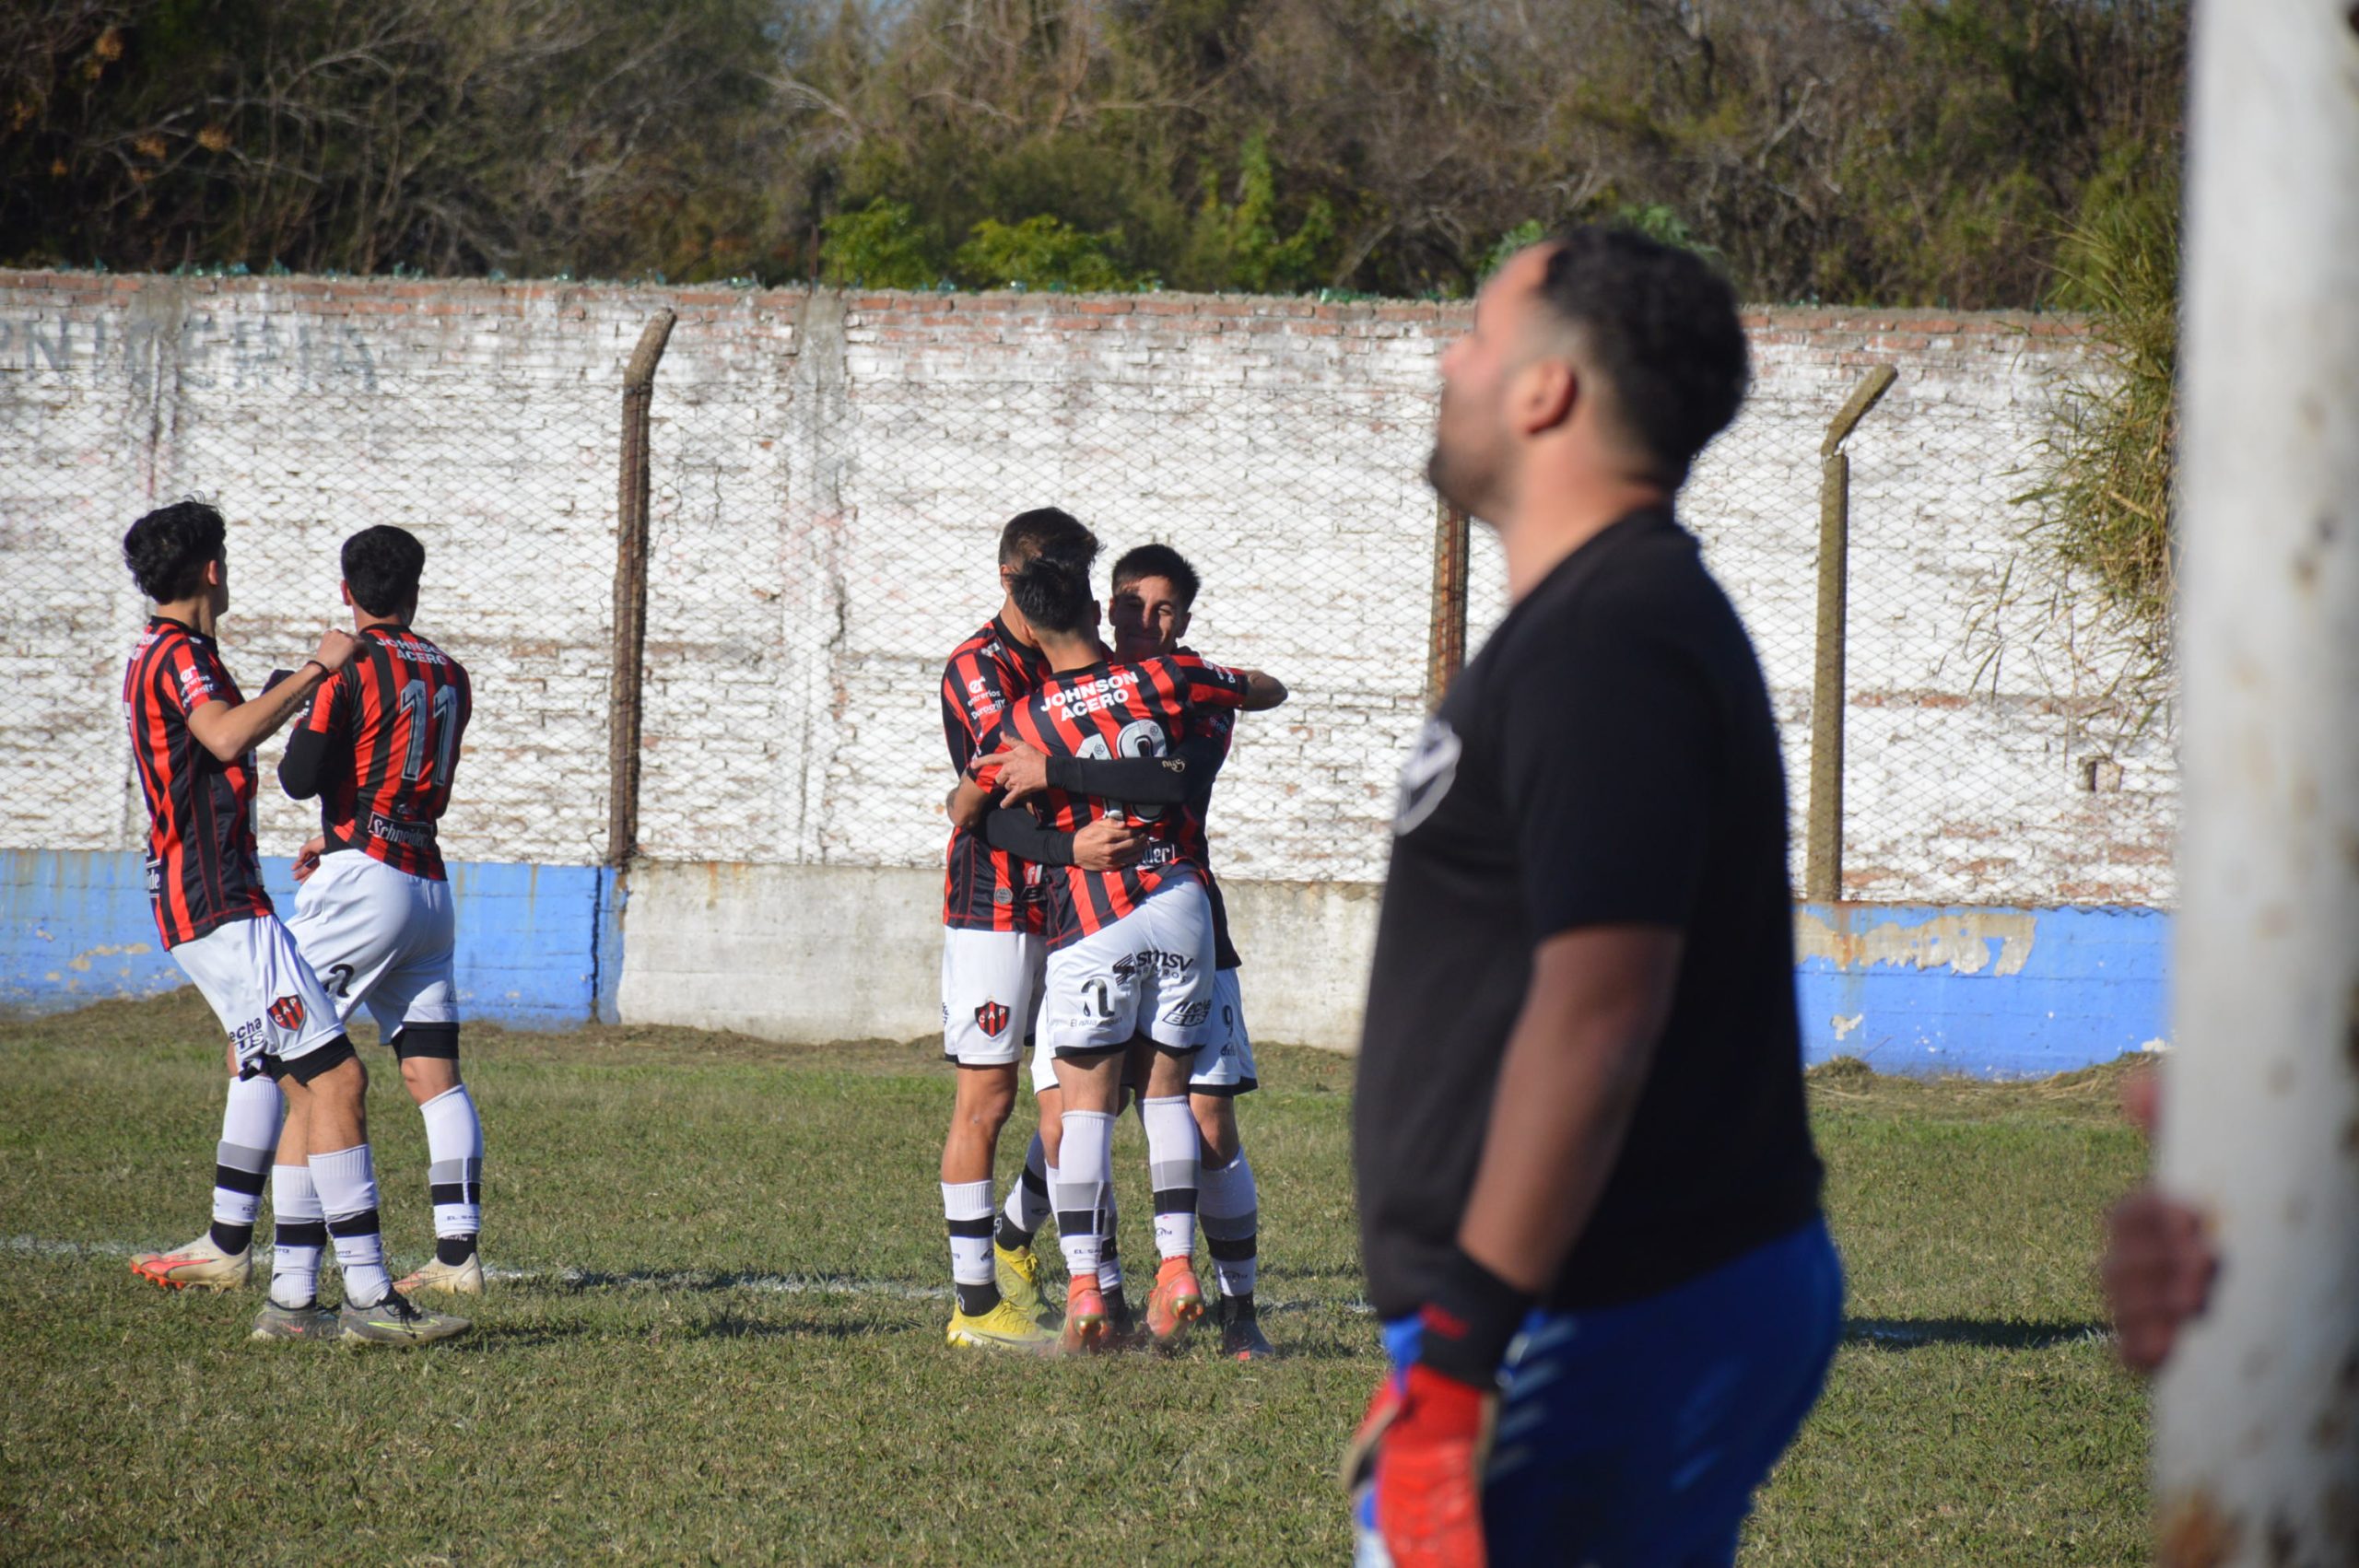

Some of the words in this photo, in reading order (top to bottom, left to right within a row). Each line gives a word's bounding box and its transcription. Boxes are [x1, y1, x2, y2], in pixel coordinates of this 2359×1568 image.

[376, 638, 449, 656] JOHNSO
[396, 649, 448, 666] ACERO
[1040, 671, 1139, 712] JOHNSON
[1062, 688, 1130, 721] ACERO
[400, 679, 457, 786] 11
[1136, 950, 1195, 972] smsv
[275, 998, 298, 1024] CAP
[978, 1007, 1006, 1024] CAP
[1167, 1013, 1205, 1026] BUS
[1221, 1004, 1234, 1037] 9
[229, 1017, 263, 1043] echa
